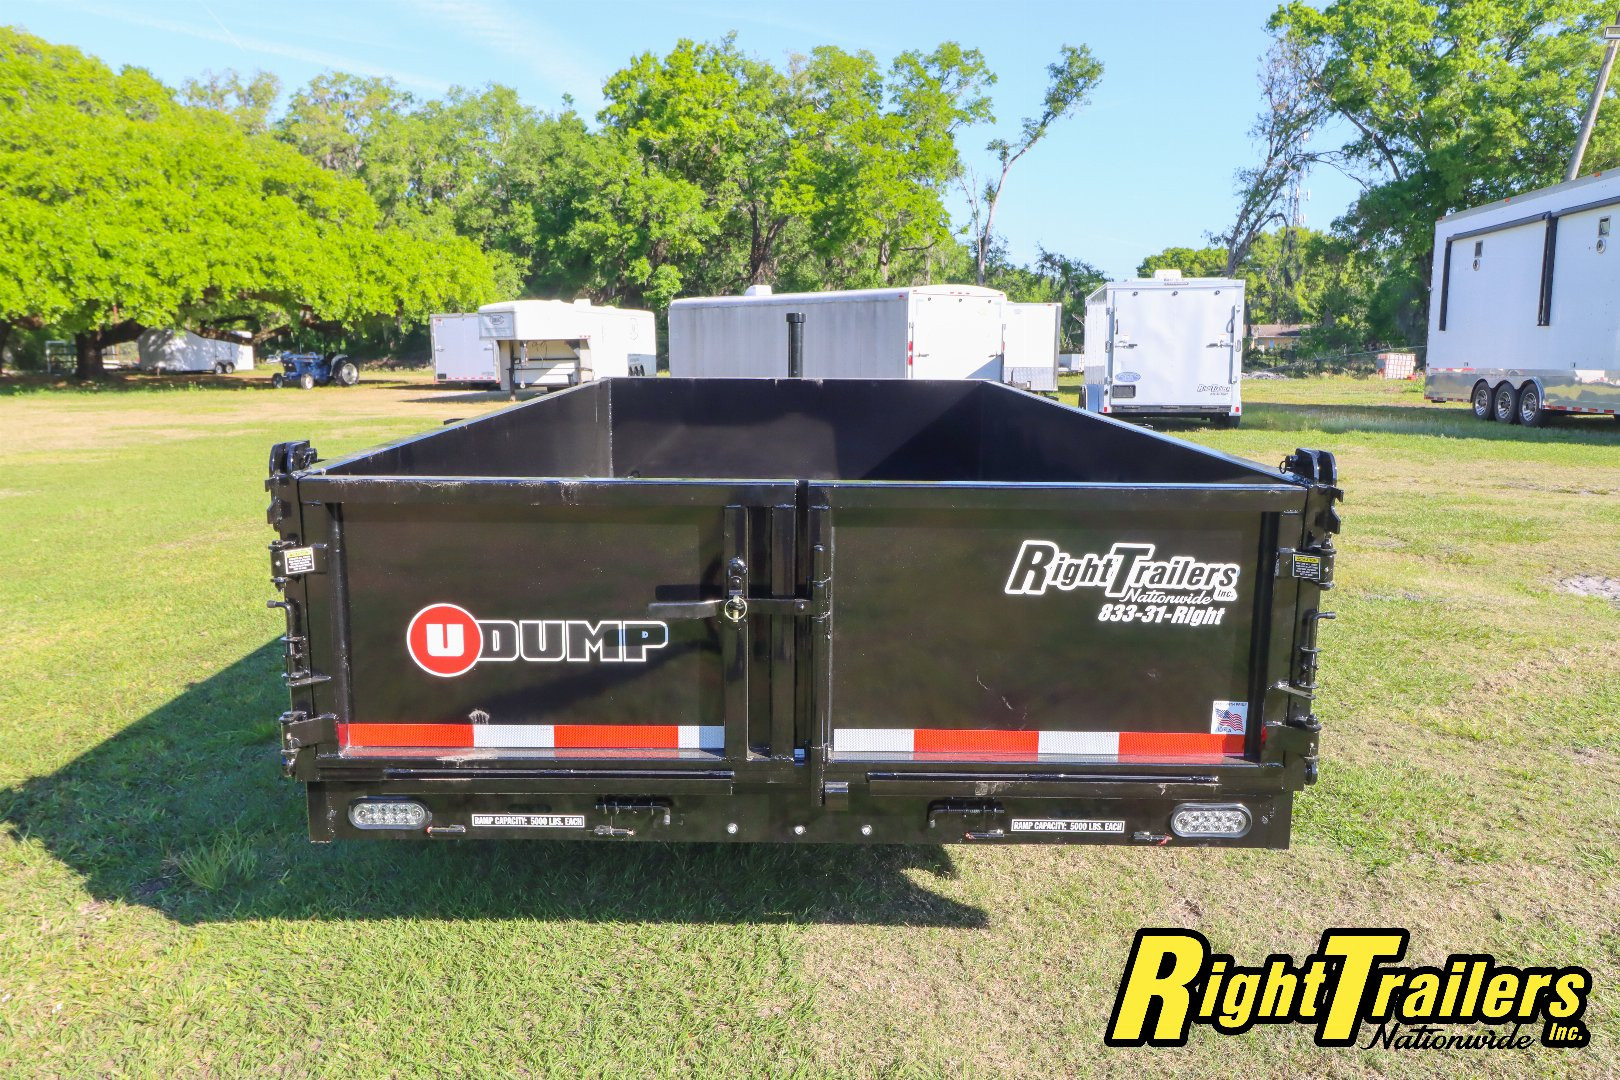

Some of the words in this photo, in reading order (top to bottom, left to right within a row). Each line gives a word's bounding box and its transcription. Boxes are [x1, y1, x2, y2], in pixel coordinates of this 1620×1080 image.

[1119, 588, 1213, 605] Nationwide
[1216, 589, 1235, 599] Inc.
[1098, 604, 1225, 626] 833-31-Right
[474, 816, 494, 825] RAMP
[494, 816, 528, 825] CAPACITY:
[530, 817, 548, 826] 5000
[548, 817, 564, 826] LBS.
[564, 817, 583, 826] EACH
[1013, 821, 1034, 830] RAMP
[1034, 821, 1067, 830] CAPACITY:
[1069, 822, 1088, 831] 5000
[1088, 822, 1103, 831] LBS.
[1104, 822, 1123, 831] EACH
